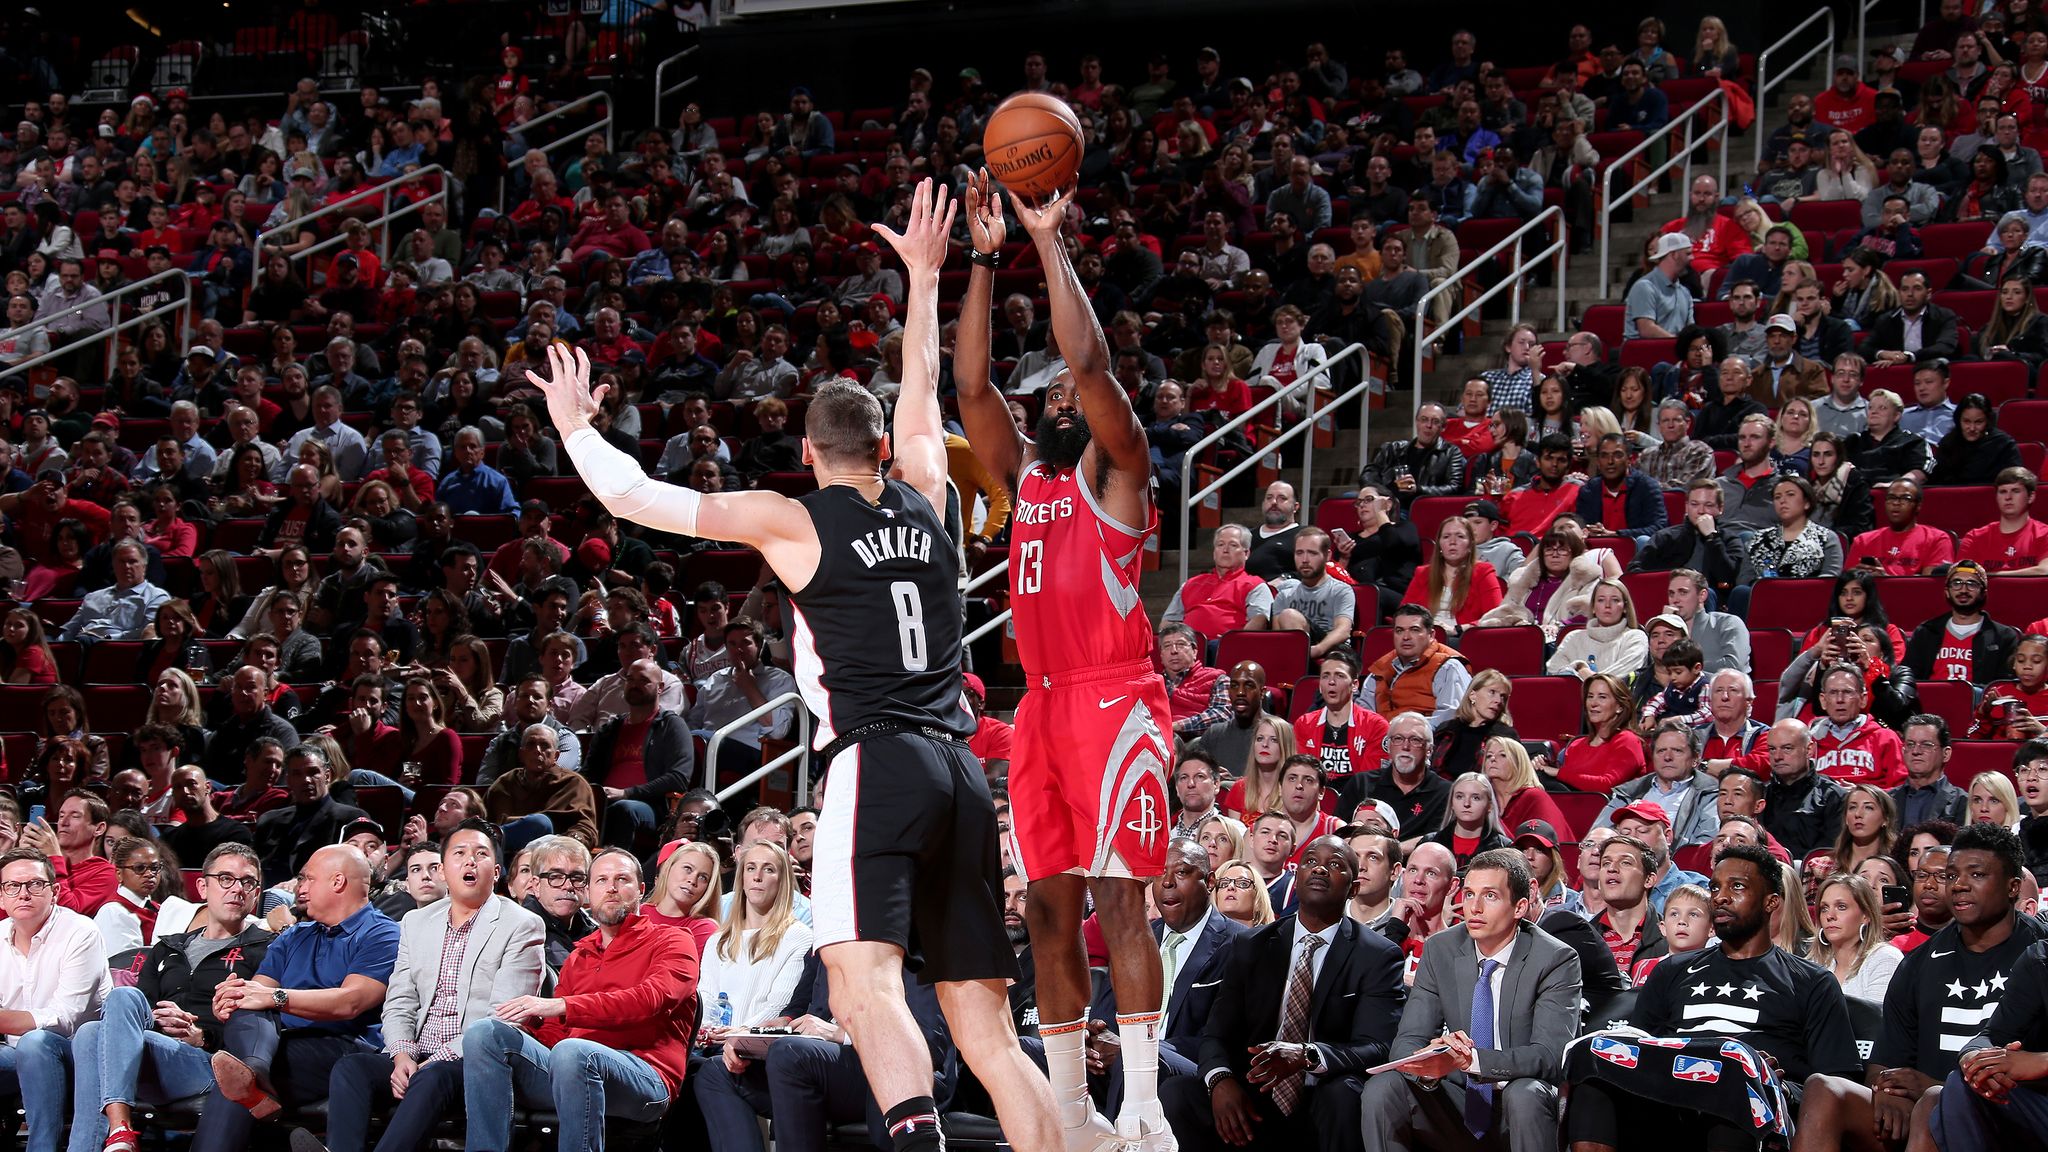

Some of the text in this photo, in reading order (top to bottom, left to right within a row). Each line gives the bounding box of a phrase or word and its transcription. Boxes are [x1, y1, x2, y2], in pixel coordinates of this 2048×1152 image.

[991, 143, 1053, 178] SPALDING
[852, 526, 931, 569] DEKKER
[1018, 540, 1043, 594] 13
[890, 581, 927, 671] 8
[1936, 647, 1972, 661] OCKE
[1947, 664, 1967, 680] 13
[1816, 749, 1875, 772] OCKETS
[1677, 1057, 1687, 1071] NBA
